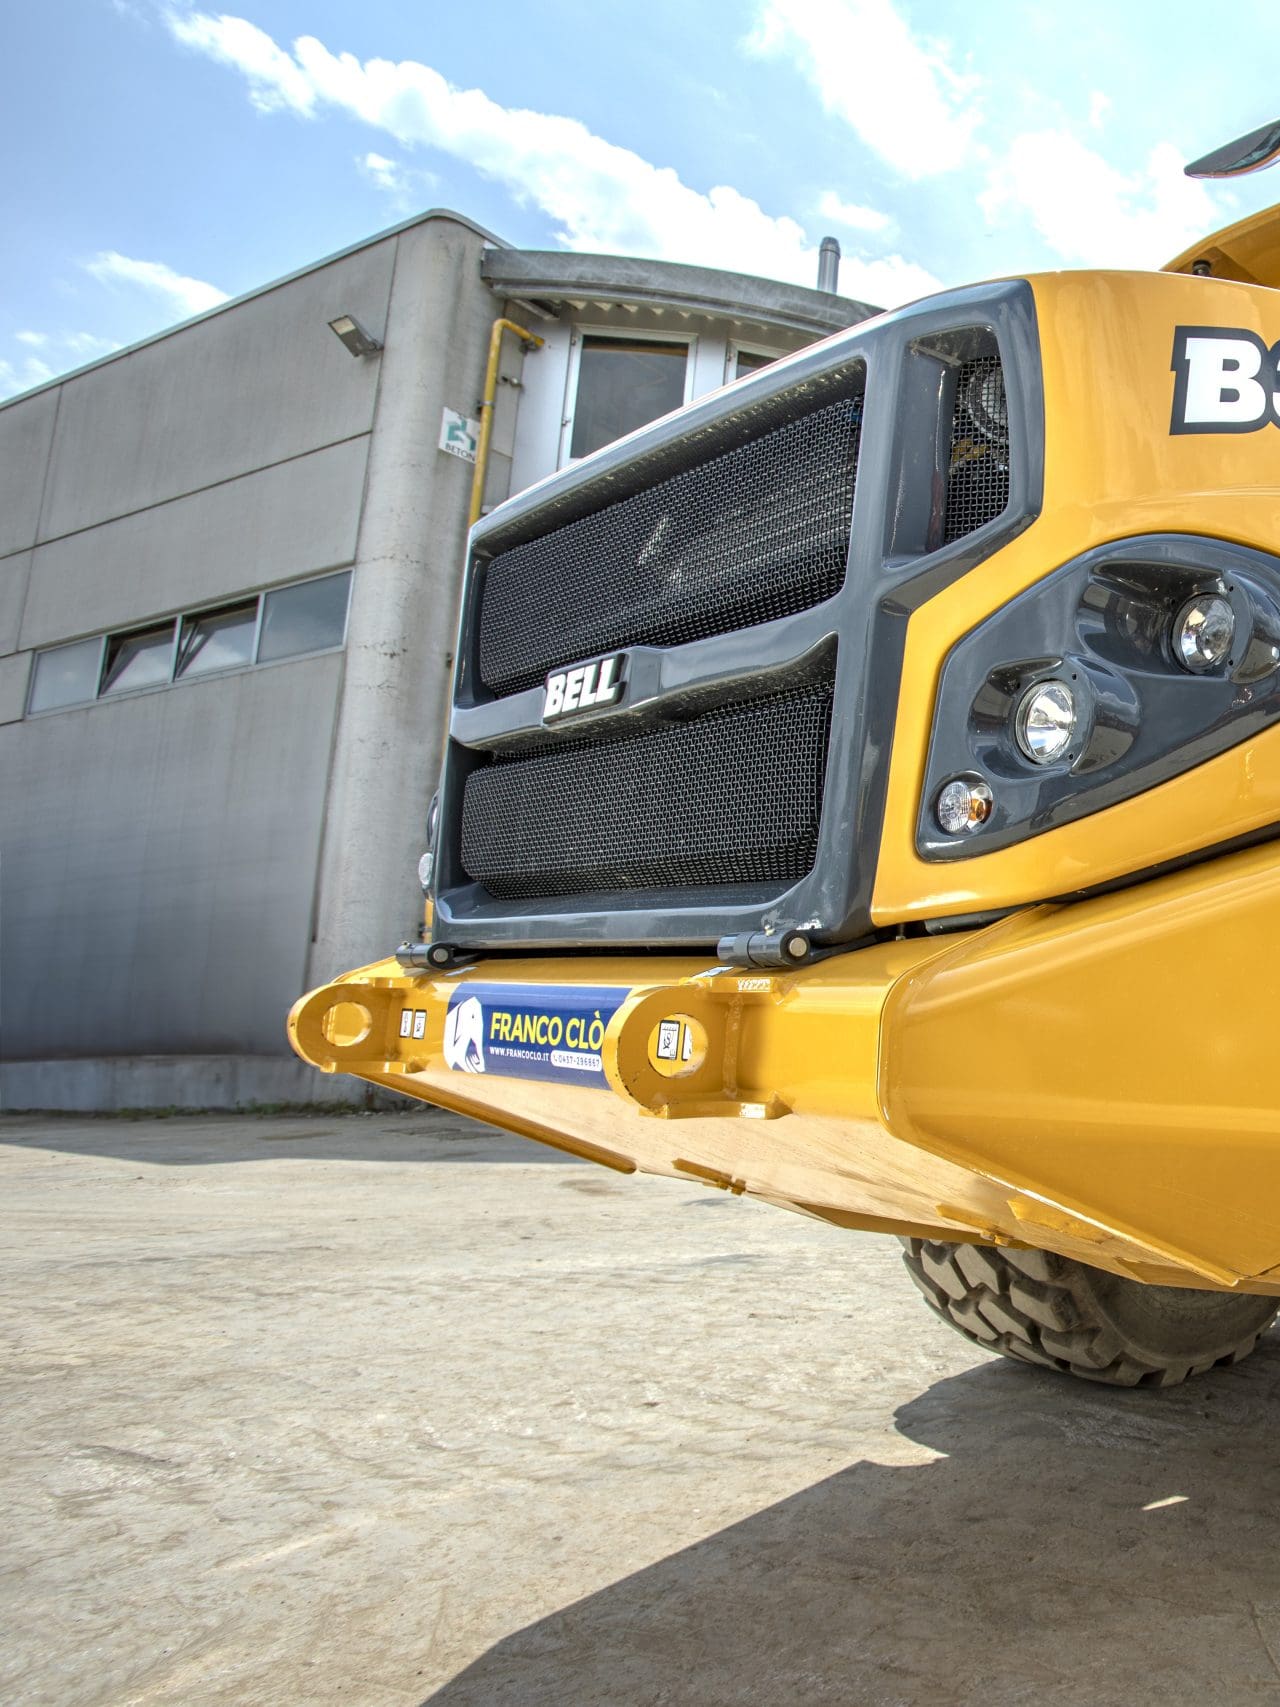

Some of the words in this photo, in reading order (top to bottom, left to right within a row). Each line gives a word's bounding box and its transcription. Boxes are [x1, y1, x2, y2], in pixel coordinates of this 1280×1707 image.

[543, 658, 616, 718] BELL
[490, 1012, 563, 1046] FRANCO
[565, 1010, 605, 1051] CLÒ
[489, 1046, 549, 1062] WWW.FRANCOCLO.IT
